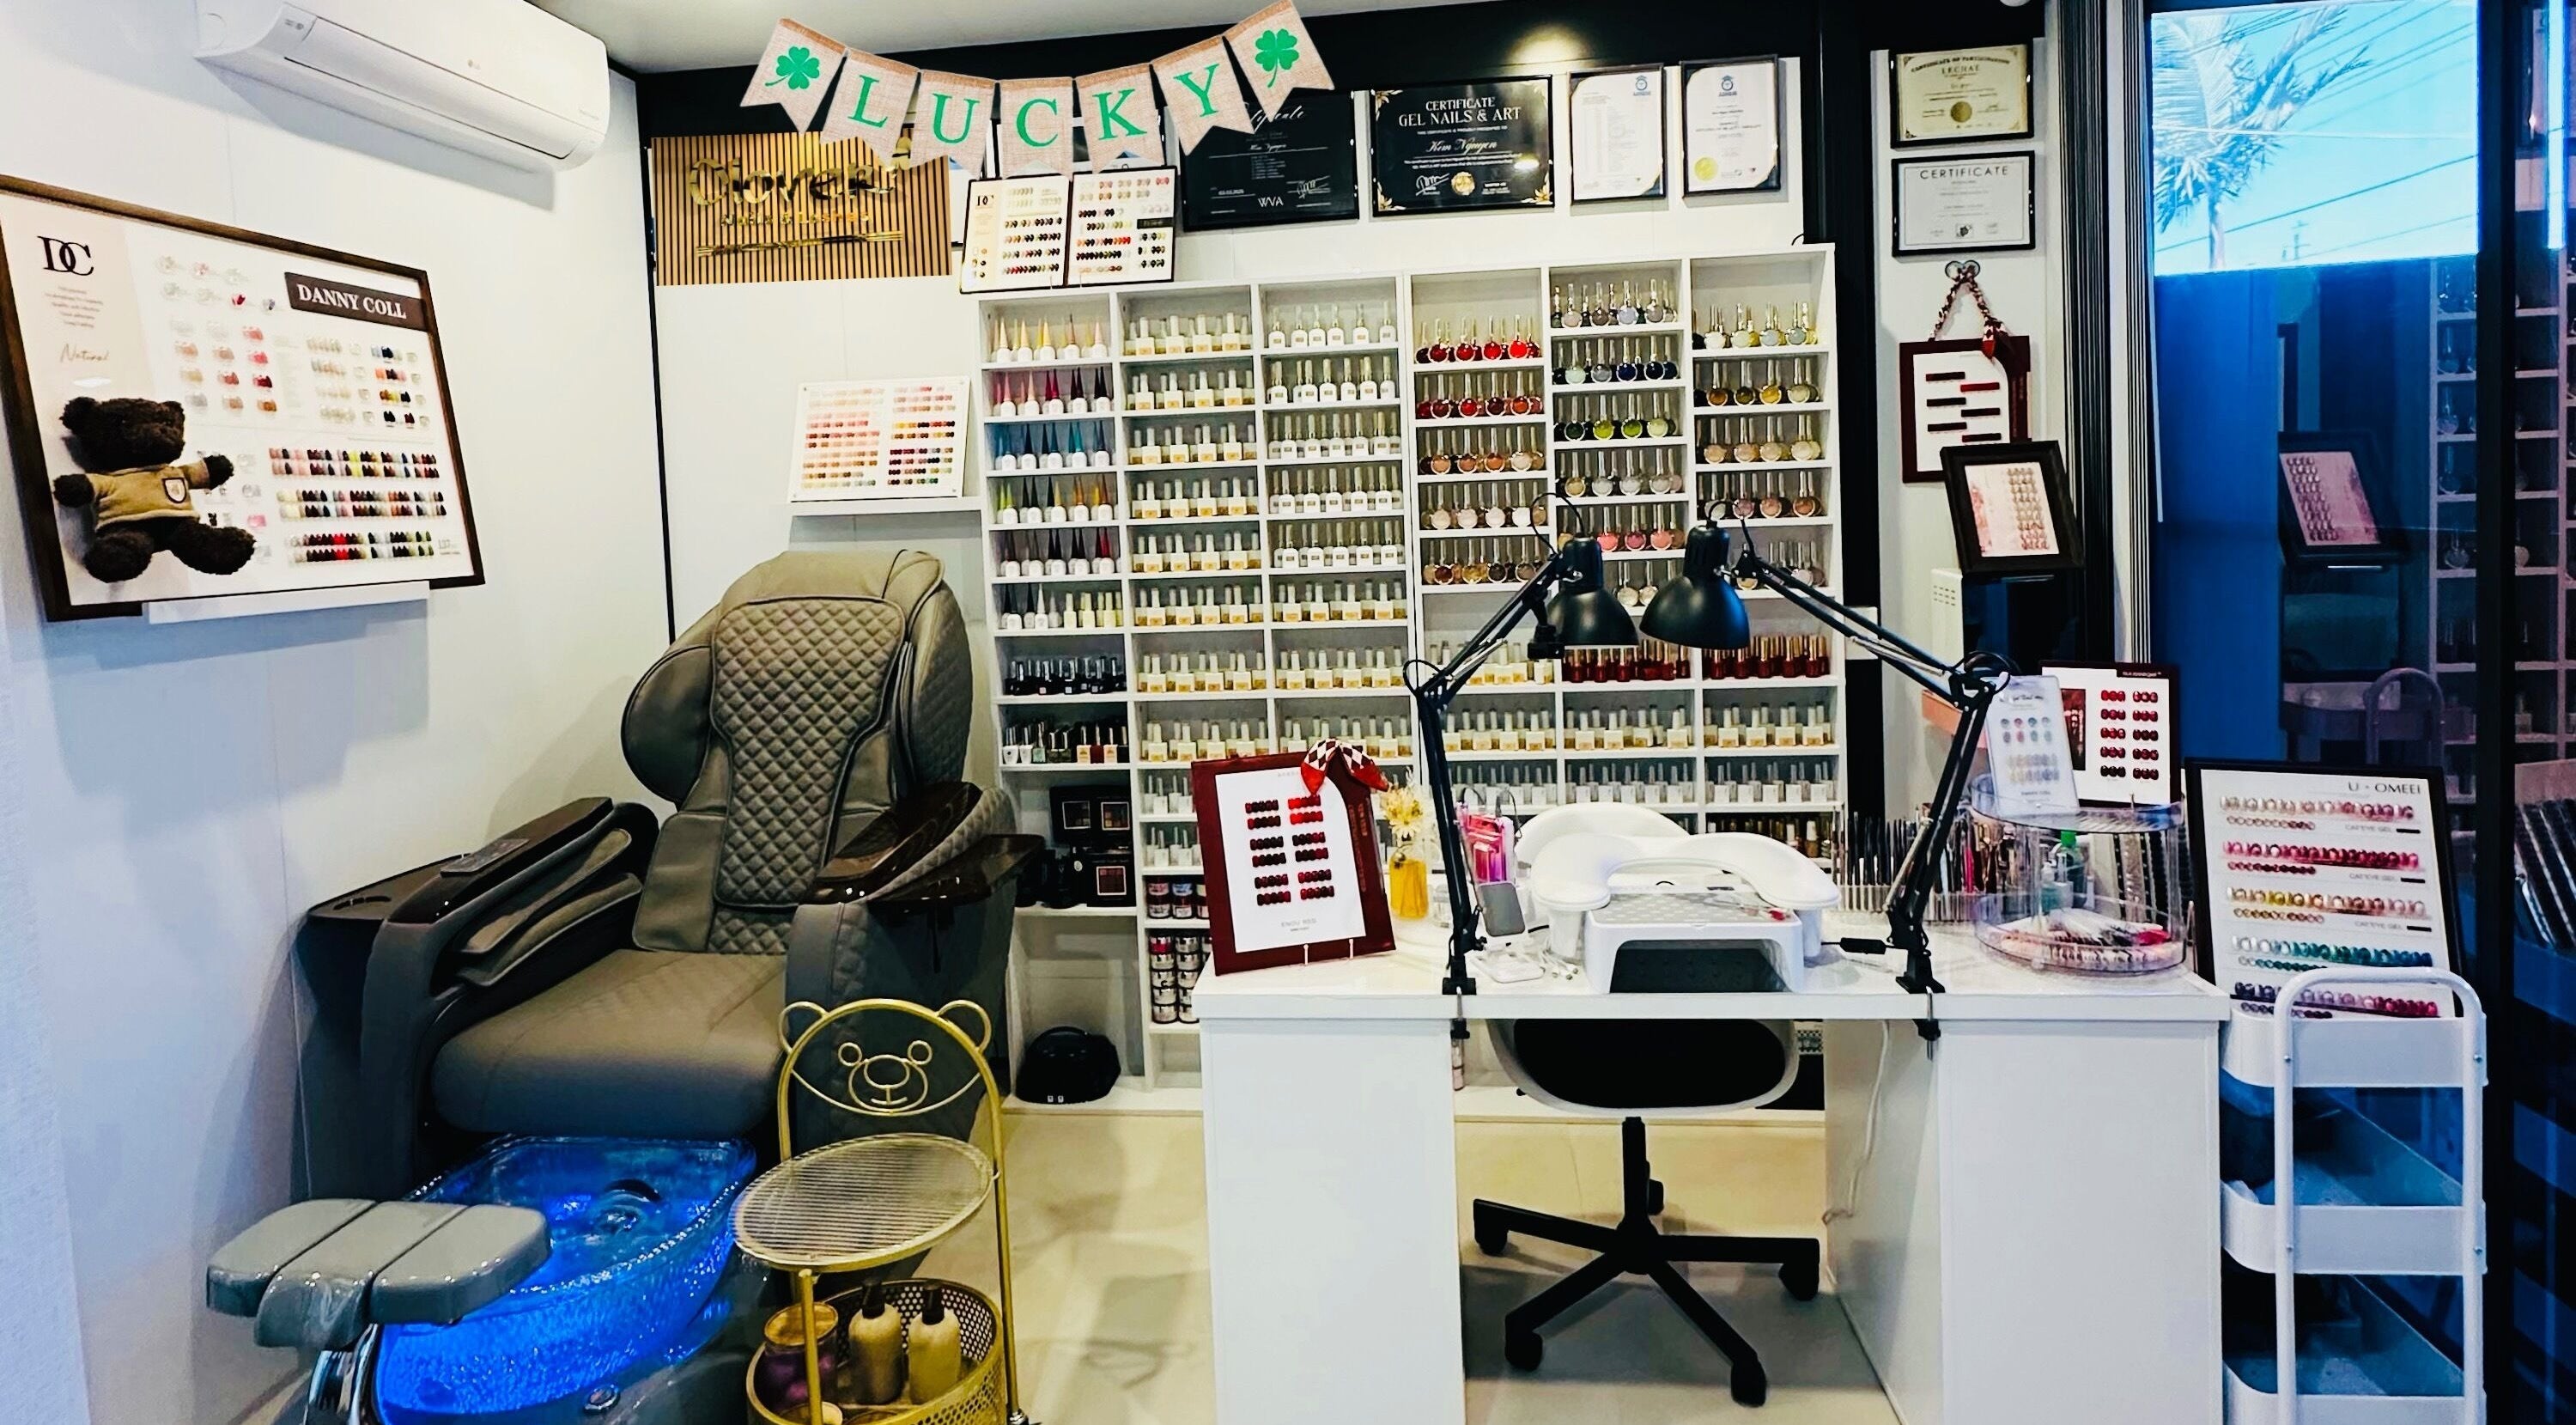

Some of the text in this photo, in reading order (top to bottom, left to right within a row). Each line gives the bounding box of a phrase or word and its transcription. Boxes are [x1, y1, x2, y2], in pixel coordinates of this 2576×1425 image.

[848, 64, 1219, 148] LUCKY
[1425, 97, 1496, 112] CERTIFICATE
[1398, 107, 1522, 127] GEL NAILS & ART
[1425, 140, 1452, 153] Kim
[1919, 166, 2008, 180] CERTIFICATE
[720, 211, 774, 227] Nails
[37, 235, 94, 277] DC
[296, 283, 407, 320] DANNY COLL
